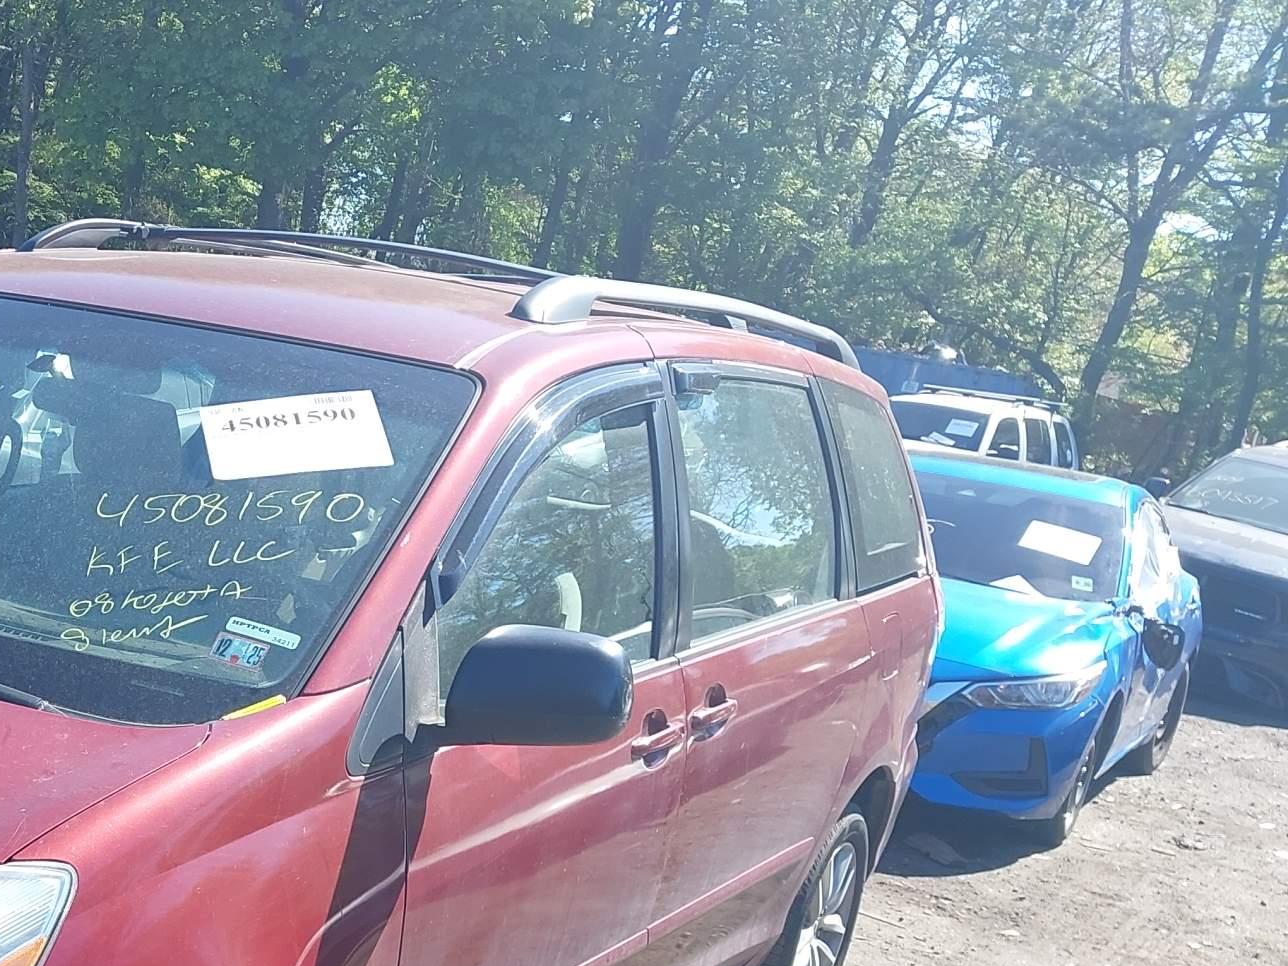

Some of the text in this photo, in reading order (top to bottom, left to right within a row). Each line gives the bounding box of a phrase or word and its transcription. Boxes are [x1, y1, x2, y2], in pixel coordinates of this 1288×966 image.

[222, 407, 356, 432] 45081590
[96, 491, 365, 527] 45081590
[207, 540, 296, 567] LLC
[213, 637, 265, 666] 12 25
